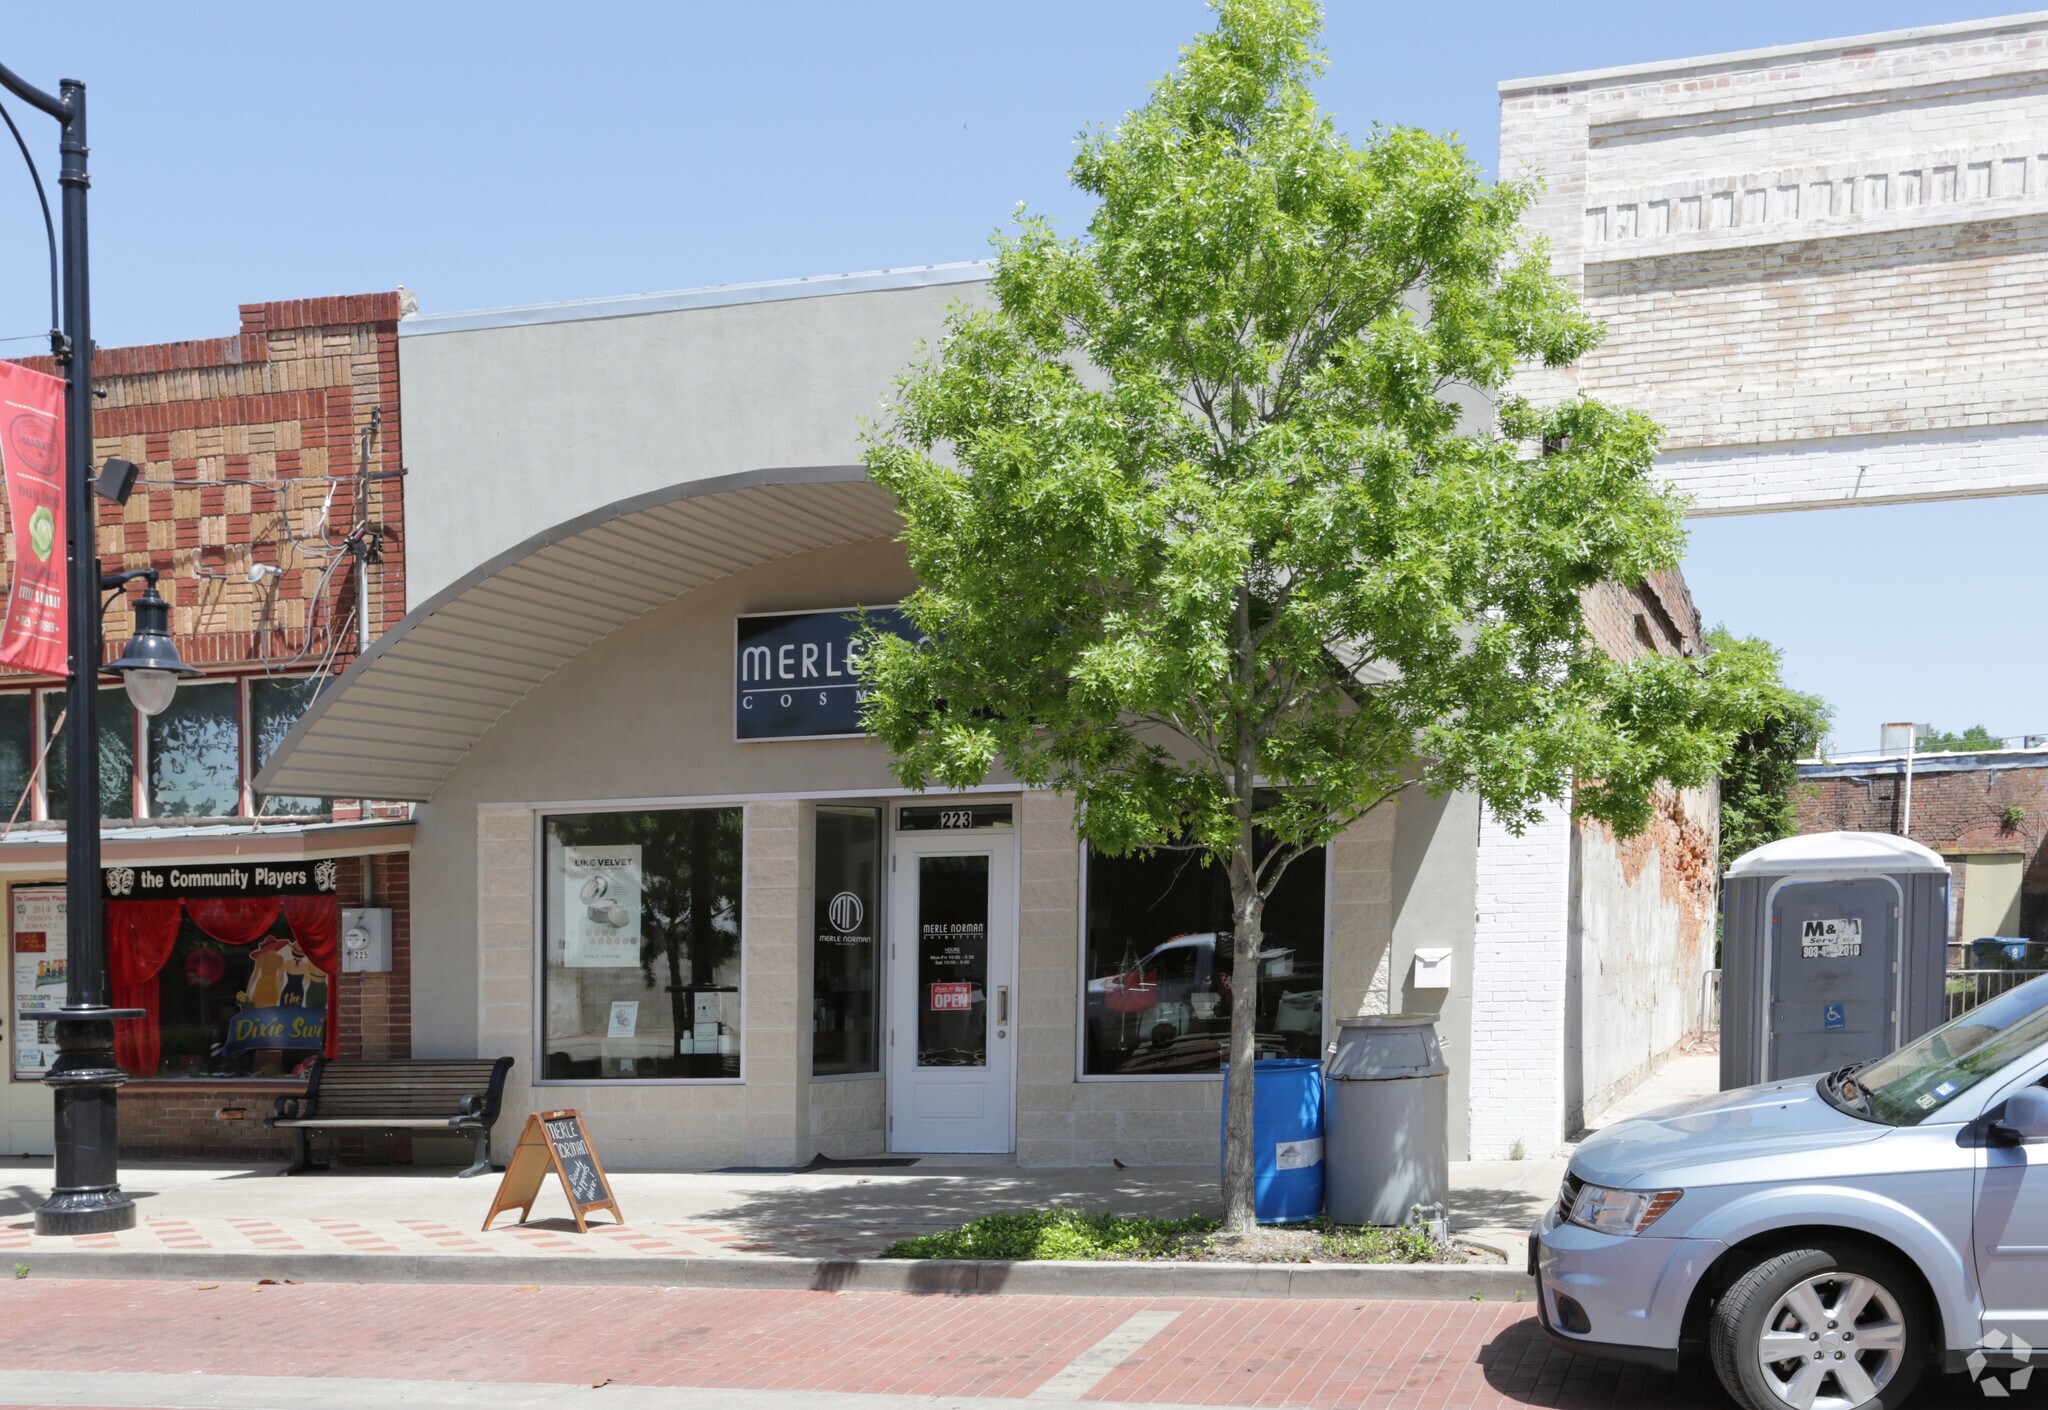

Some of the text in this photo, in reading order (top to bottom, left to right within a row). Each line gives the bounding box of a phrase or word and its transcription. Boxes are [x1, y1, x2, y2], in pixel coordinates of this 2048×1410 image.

[742, 640, 864, 682] MERLE
[942, 811, 971, 829] 223
[574, 858, 632, 867] LIKE VELVET
[141, 867, 307, 890] the Community Players
[923, 923, 984, 934] MERLE NORMAN
[819, 935, 872, 943] MERLE NORMAN
[354, 951, 369, 960] 225
[284, 992, 300, 1005] the
[934, 993, 968, 1008] OPEN
[235, 1017, 285, 1042] Dixie
[545, 1121, 578, 1140] MERLE
[552, 1139, 589, 1159] NORMAN
